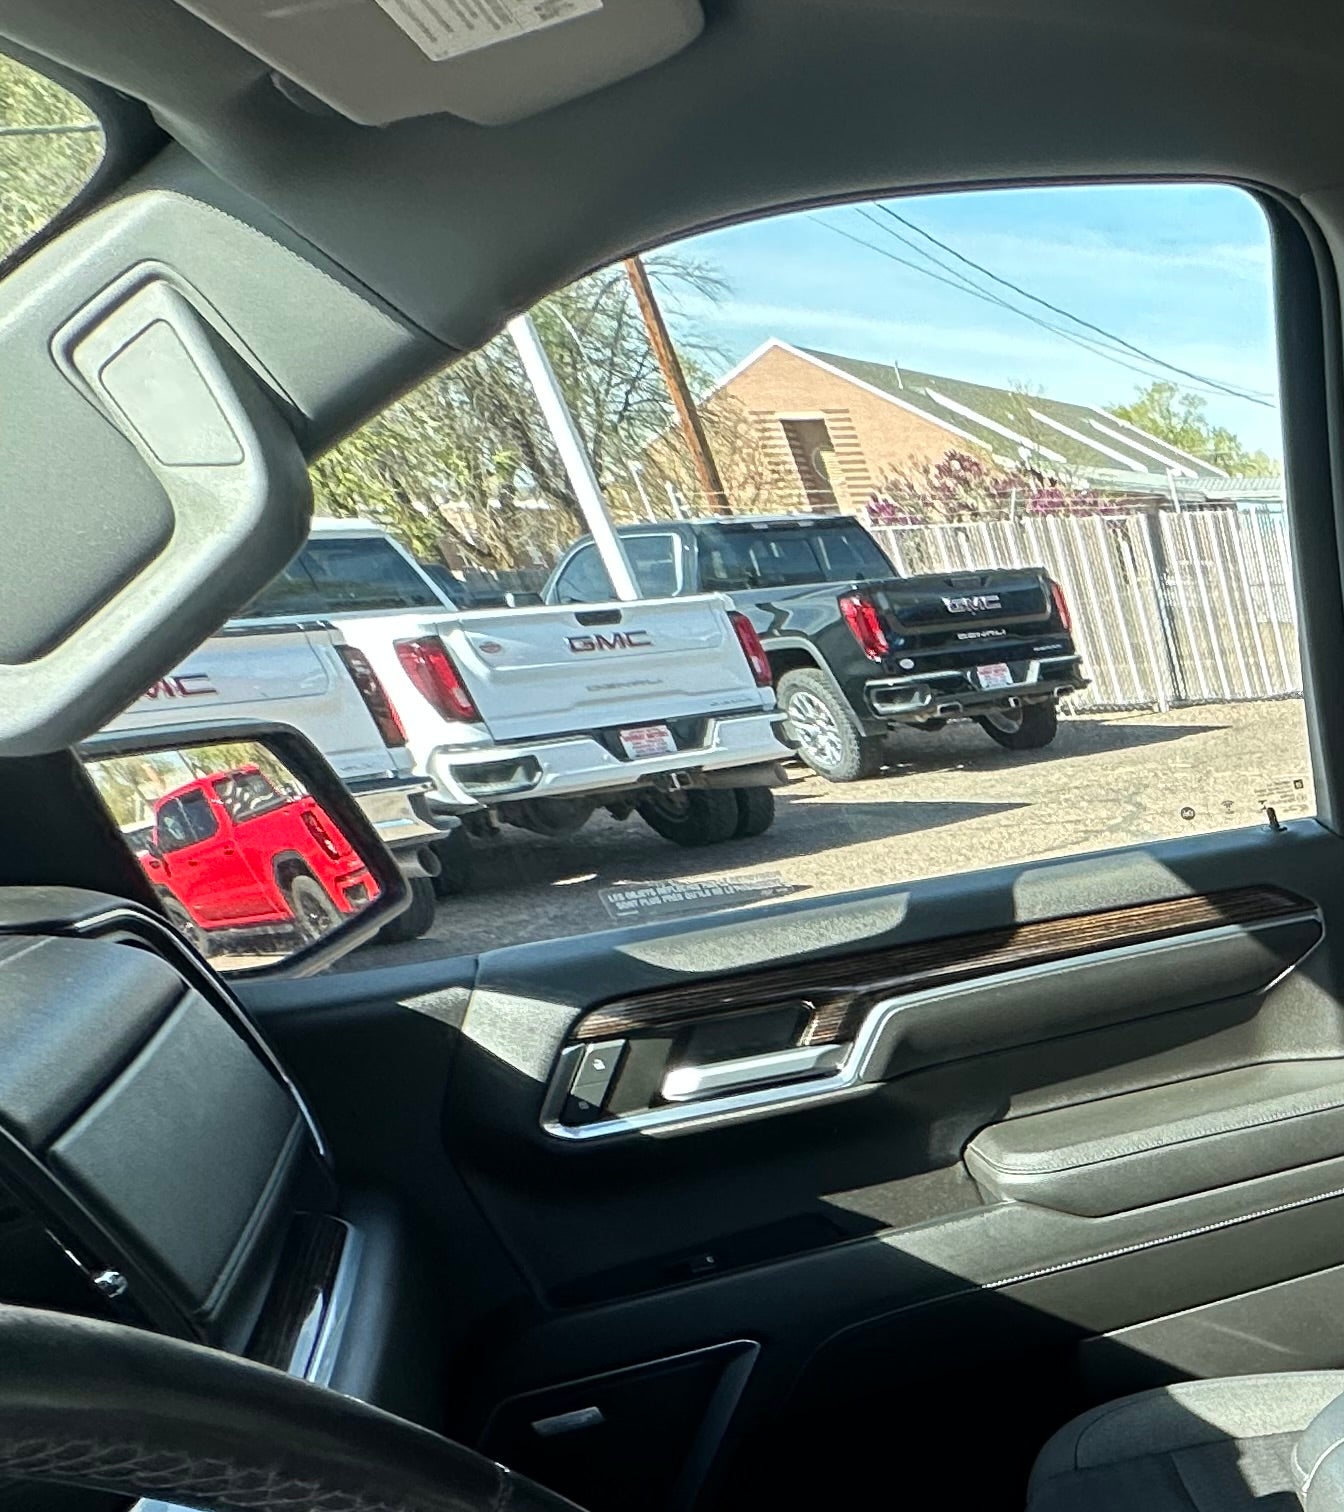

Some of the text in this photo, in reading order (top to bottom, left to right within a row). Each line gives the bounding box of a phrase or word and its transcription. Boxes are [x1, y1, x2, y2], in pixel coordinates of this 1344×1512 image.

[942, 594, 1002, 615] GMC
[566, 629, 653, 653] GMC
[146, 672, 218, 699] MC
